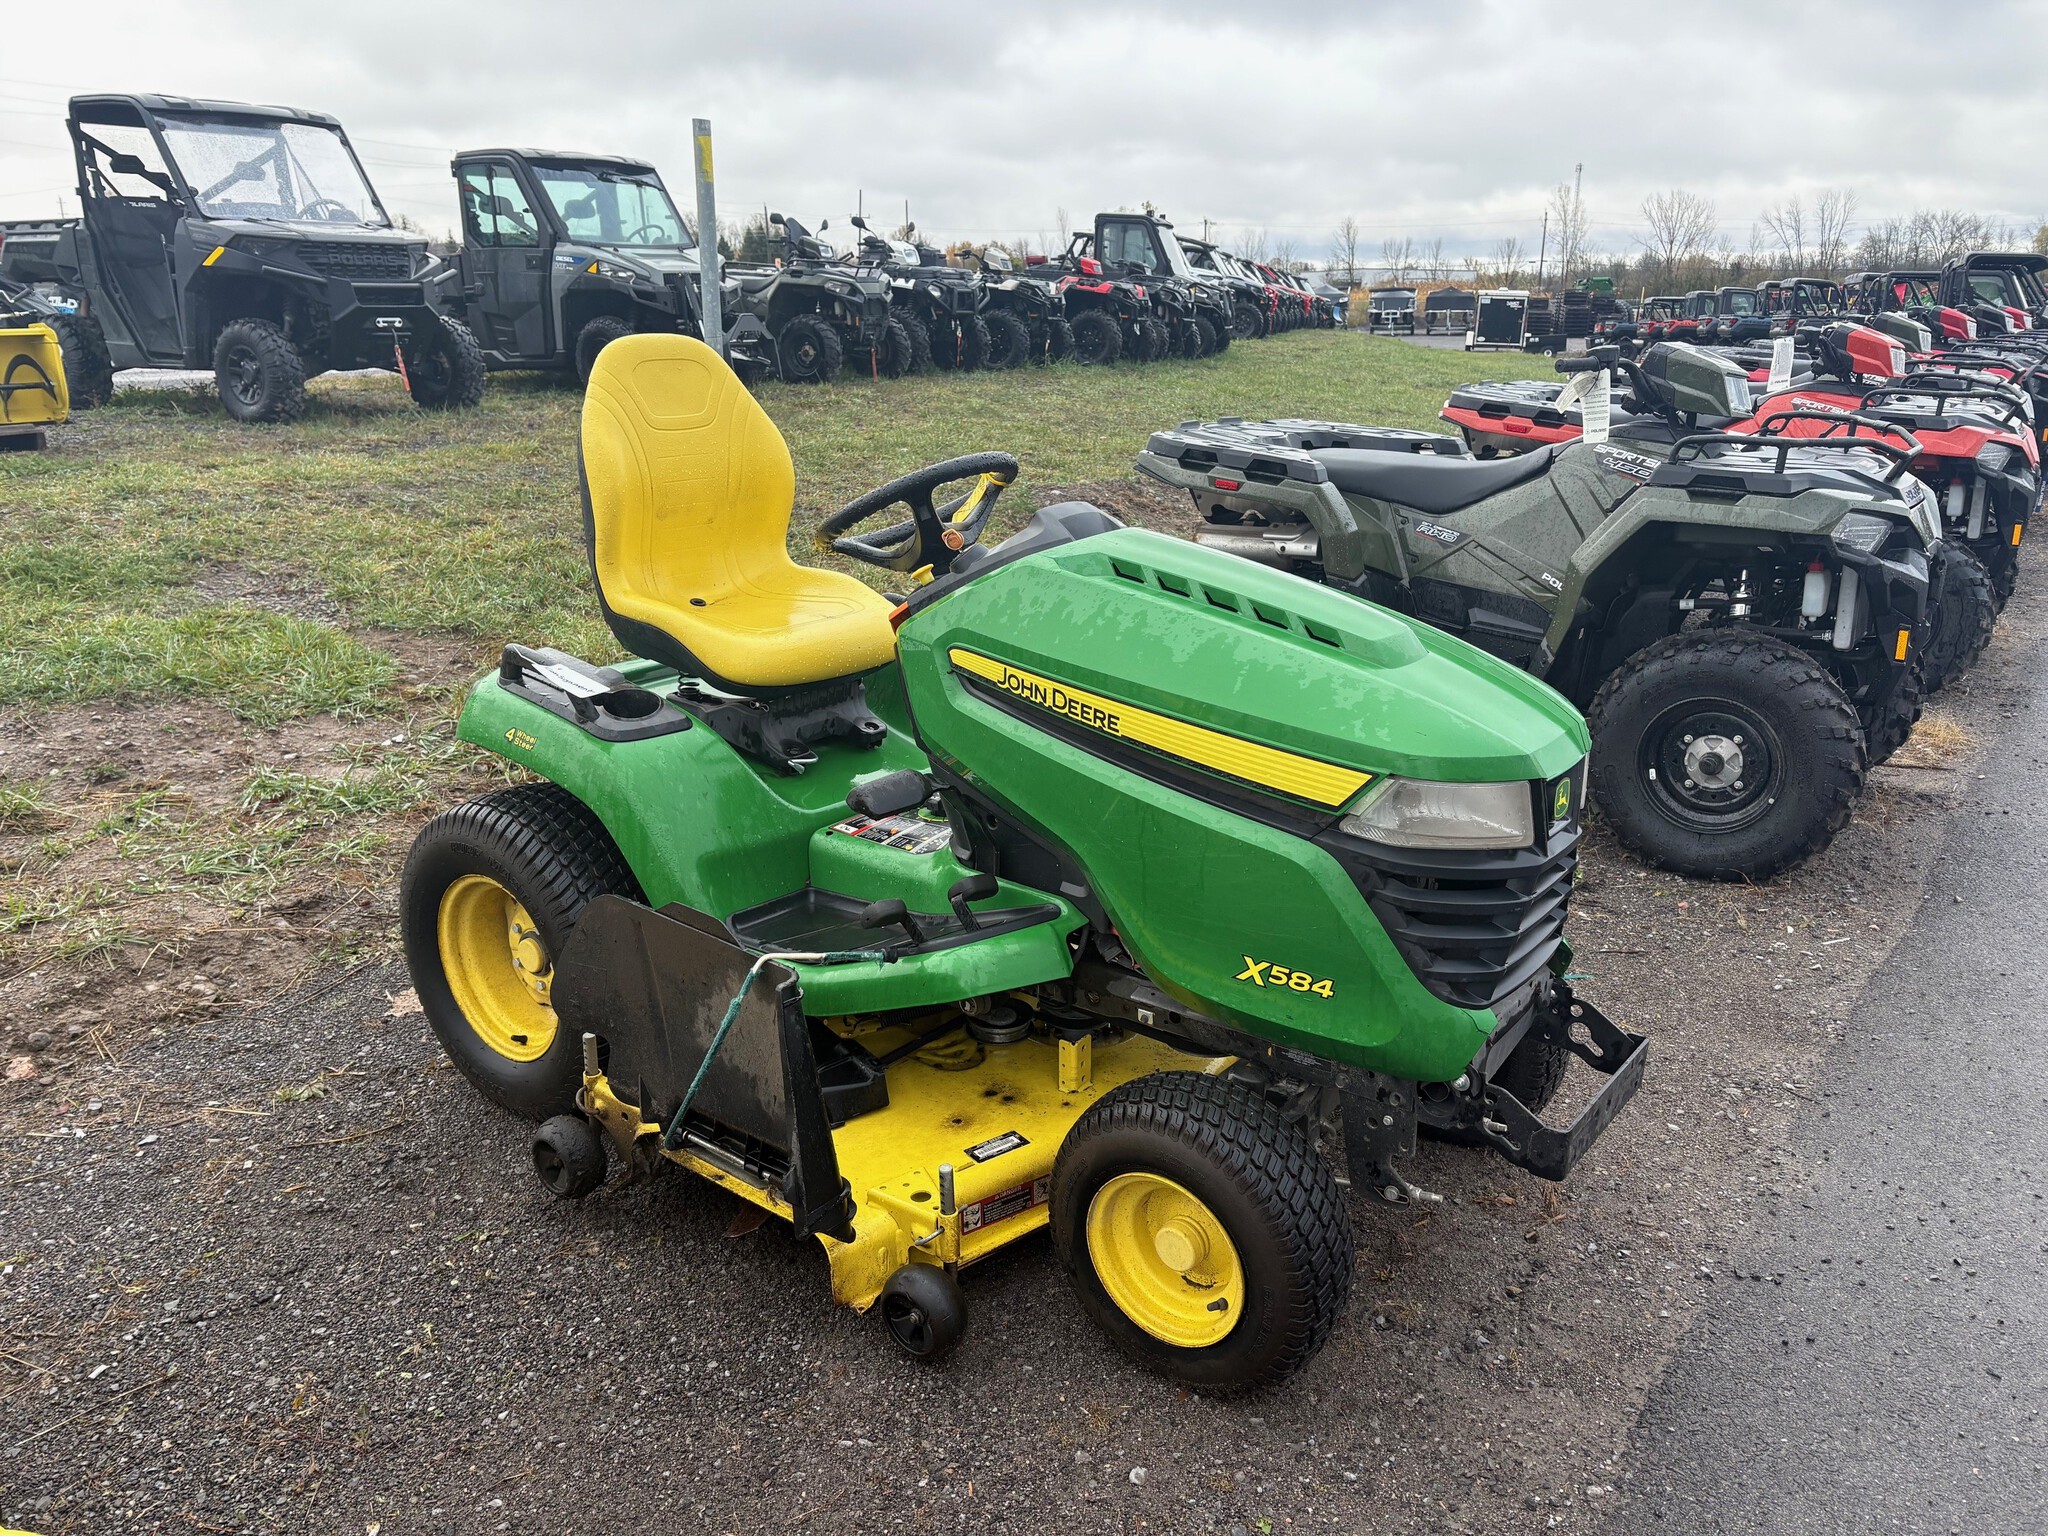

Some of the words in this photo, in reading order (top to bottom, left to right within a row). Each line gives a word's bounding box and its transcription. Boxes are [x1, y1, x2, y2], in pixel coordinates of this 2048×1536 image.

[328, 253, 399, 266] POLARIS
[1416, 524, 1458, 542] AWD
[997, 667, 1047, 704] JOHN
[1051, 687, 1120, 734] DEERE
[504, 727, 516, 742] 4
[516, 729, 538, 744] Wheel
[513, 737, 534, 751] Steer
[1232, 953, 1336, 999] X584
